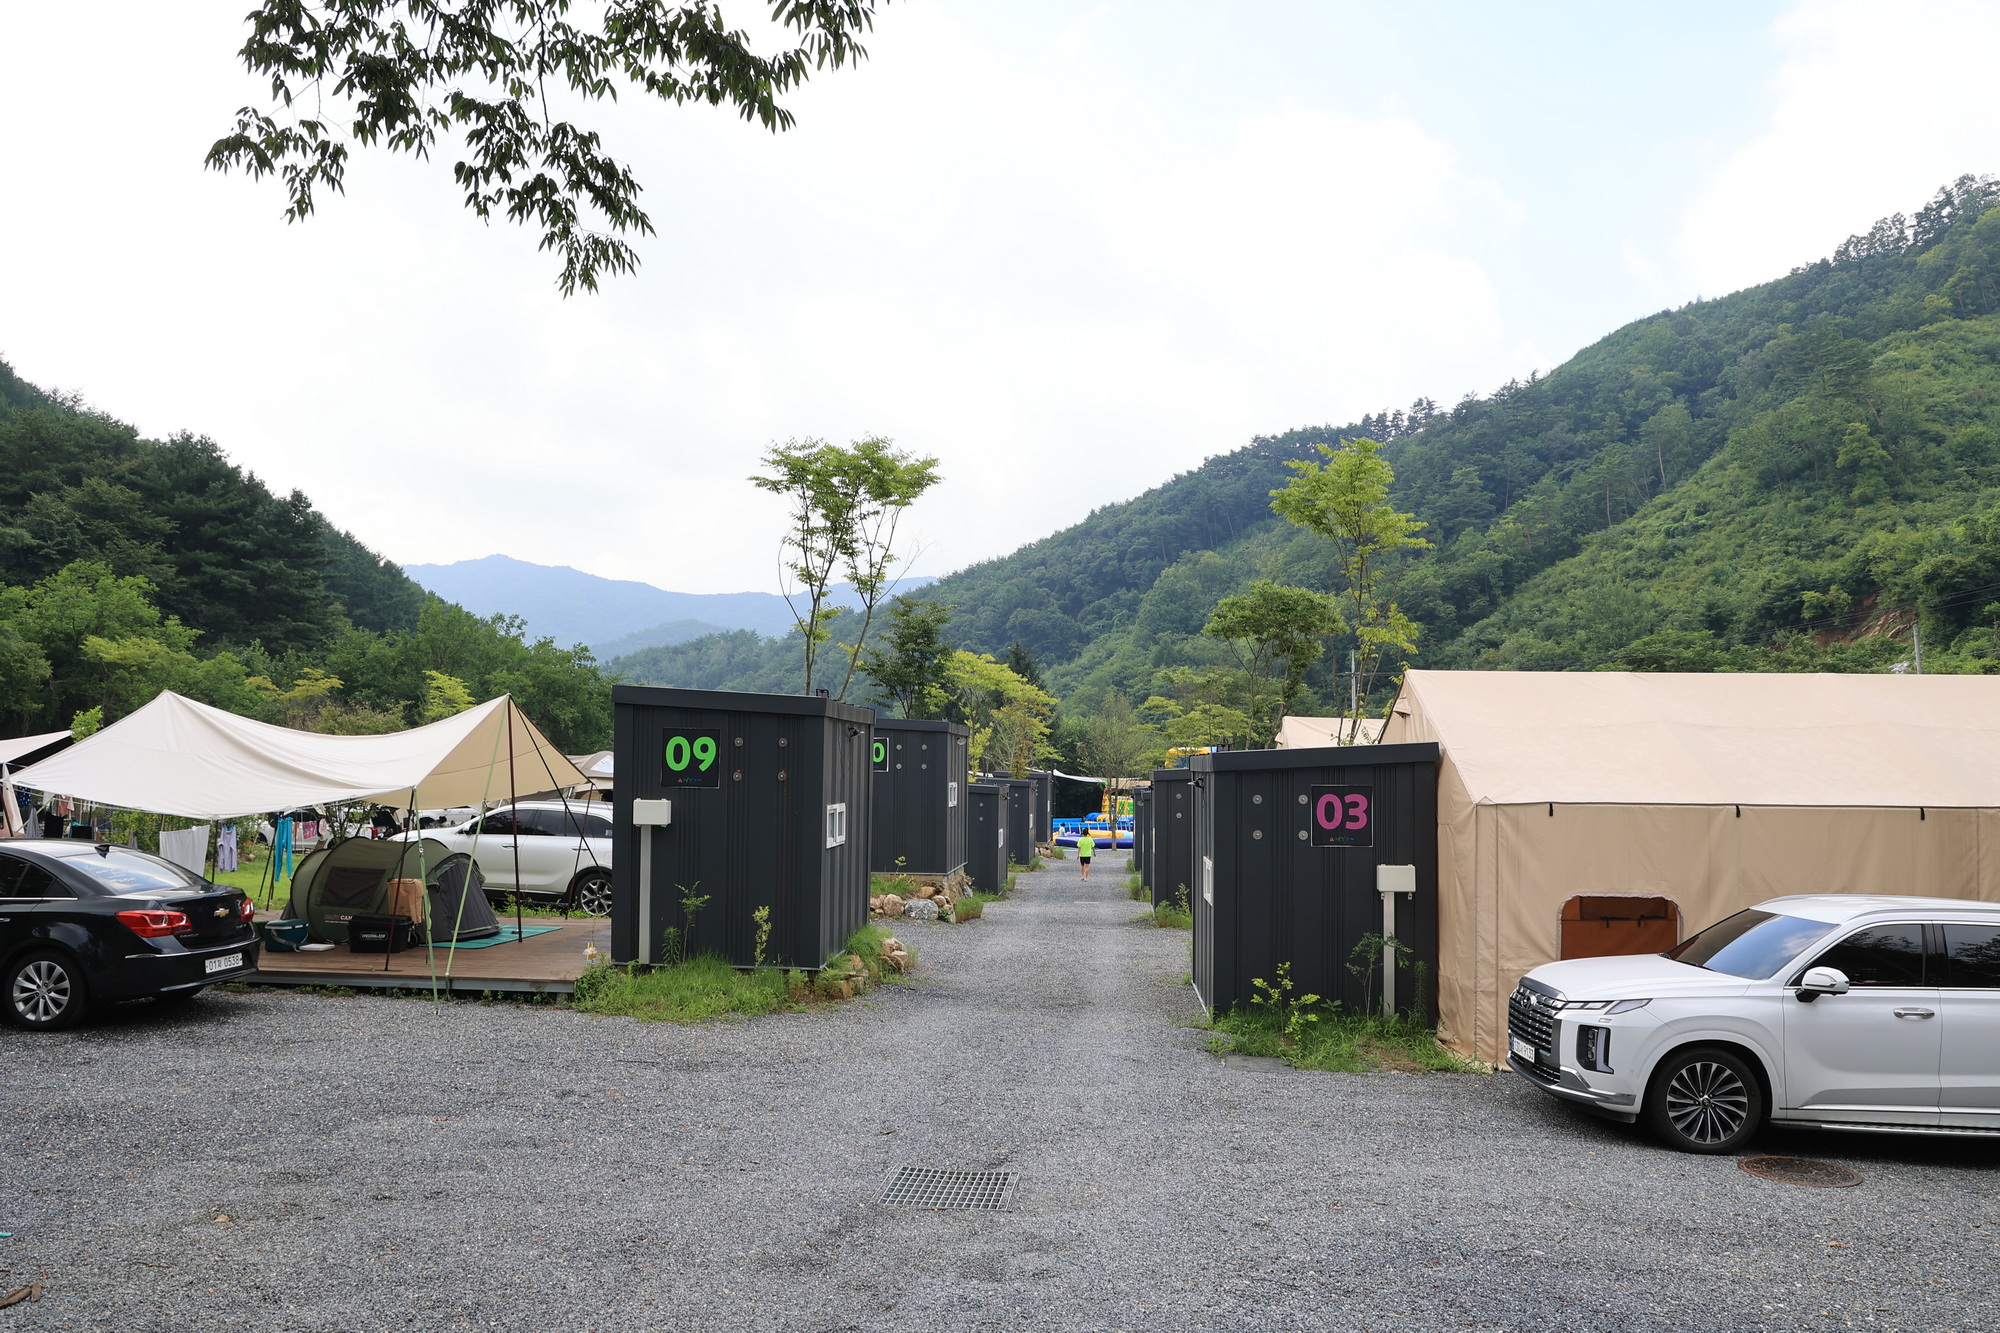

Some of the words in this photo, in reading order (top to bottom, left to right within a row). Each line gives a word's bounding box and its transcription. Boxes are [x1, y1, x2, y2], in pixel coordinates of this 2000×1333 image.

[665, 735, 717, 772] 09
[872, 742, 885, 763] 0
[1316, 793, 1368, 830] 03
